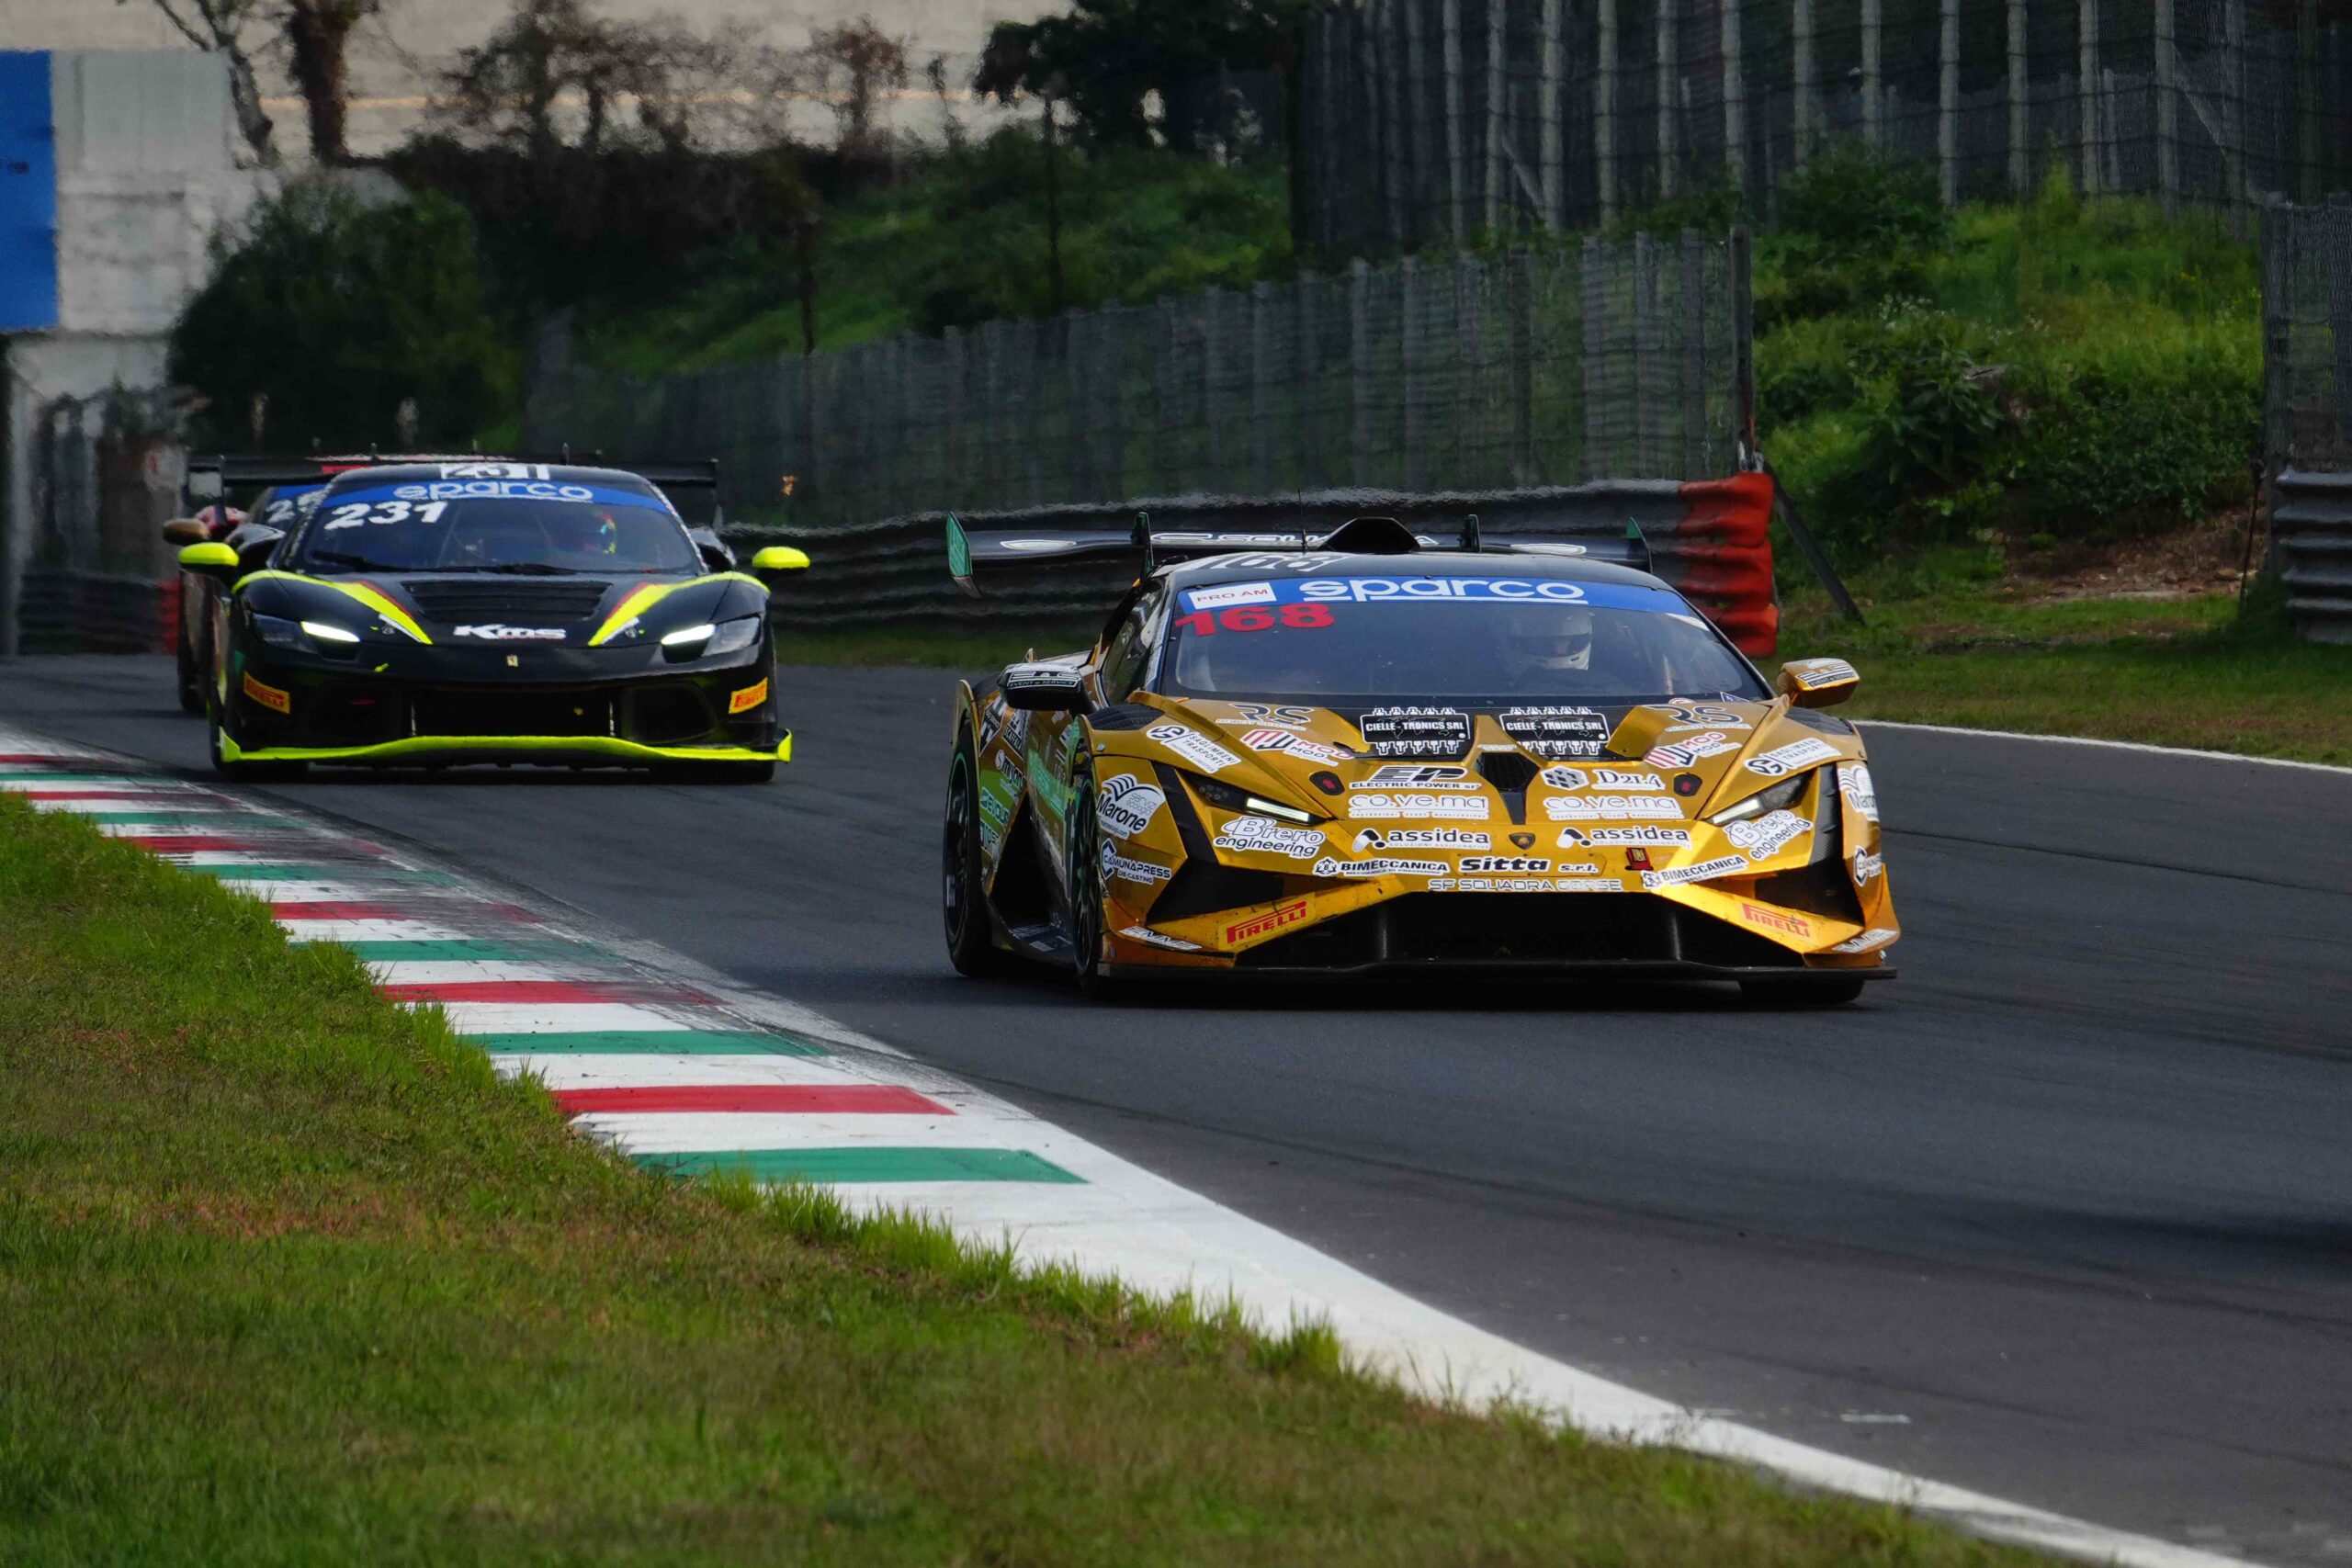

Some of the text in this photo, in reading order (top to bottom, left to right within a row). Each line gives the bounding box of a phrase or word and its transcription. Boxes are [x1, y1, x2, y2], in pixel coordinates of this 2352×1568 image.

[393, 480, 594, 501] sparco
[323, 501, 447, 530] 231
[1196, 588, 1269, 603] PRO AM
[1299, 578, 1588, 604] sparco
[1174, 602, 1336, 637] 168
[1228, 702, 1313, 725] RS
[1365, 722, 1396, 732] CIELLE
[1402, 721, 1445, 730] TRONICS
[1446, 721, 1465, 730] SRL
[1506, 722, 1537, 731] CIELLE
[1542, 721, 1584, 730] TRONICS
[1584, 721, 1604, 730] SRL
[1182, 739, 1226, 766] TRASPORTI
[1189, 735, 1237, 763] SAGLIMBENI
[1097, 794, 1147, 831] Marone
[1352, 795, 1486, 808] co.ve.ma
[1546, 796, 1678, 810] co.ve.ma
[1225, 817, 1325, 844] Brero
[1389, 829, 1489, 843] assidea
[1592, 827, 1689, 840] assidea
[1727, 809, 1793, 846] Brero
[1750, 818, 1811, 859] engineering
[1216, 837, 1317, 857] engineering
[1104, 855, 1170, 878] CAMUNAPRESS
[1341, 860, 1448, 871] BIMECCANICA
[1460, 857, 1550, 872] sitta
[1560, 863, 1598, 872] s.r.l.
[1660, 856, 1746, 881] BIMECCANICA
[1429, 879, 1623, 891] SF SQUADRA CORSE
[1227, 900, 1307, 944] PIRELLI
[1740, 902, 1810, 938] PIRELLI
